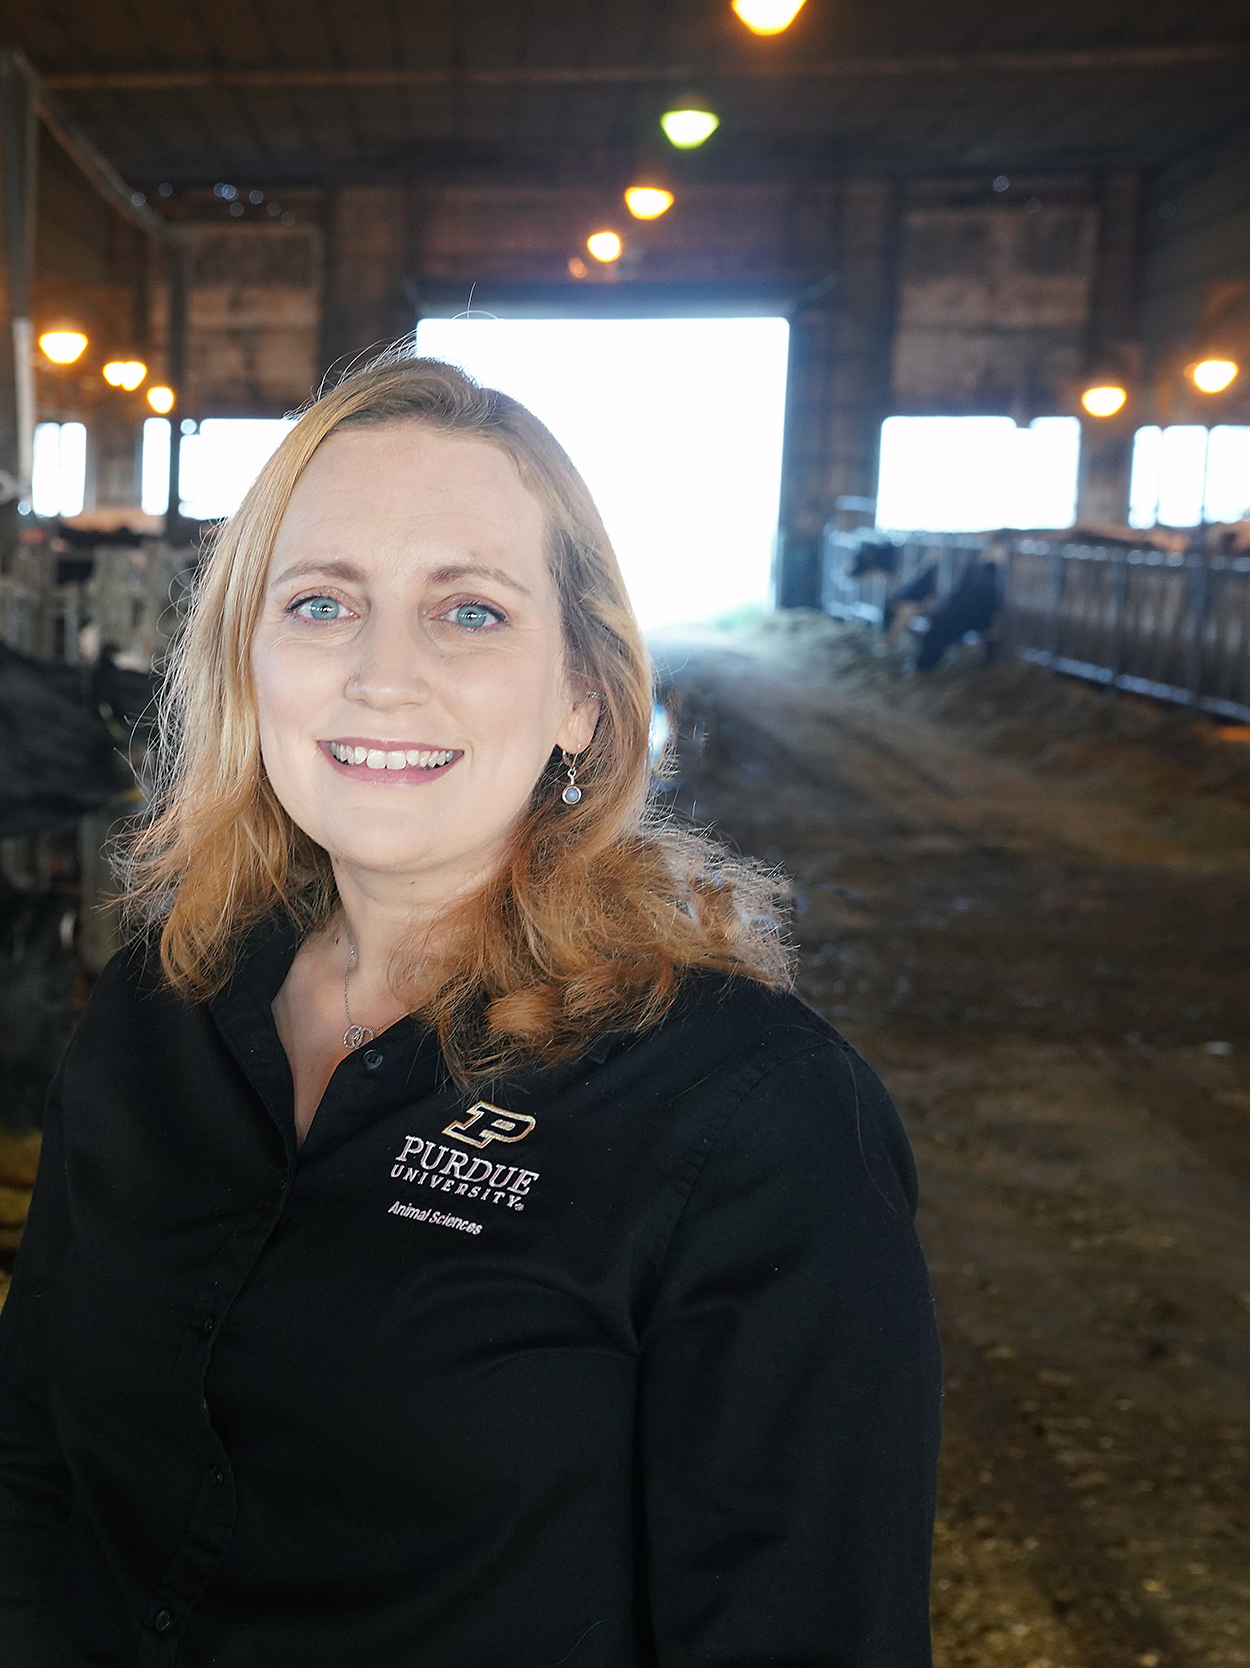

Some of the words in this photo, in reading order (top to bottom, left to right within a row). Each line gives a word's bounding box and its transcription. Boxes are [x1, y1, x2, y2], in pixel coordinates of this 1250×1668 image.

[442, 1101, 536, 1149] P
[390, 1164, 522, 1208] UNIVERSITY
[395, 1135, 540, 1195] PURDUE
[388, 1200, 432, 1221] Animal
[428, 1210, 483, 1235] Sciences
